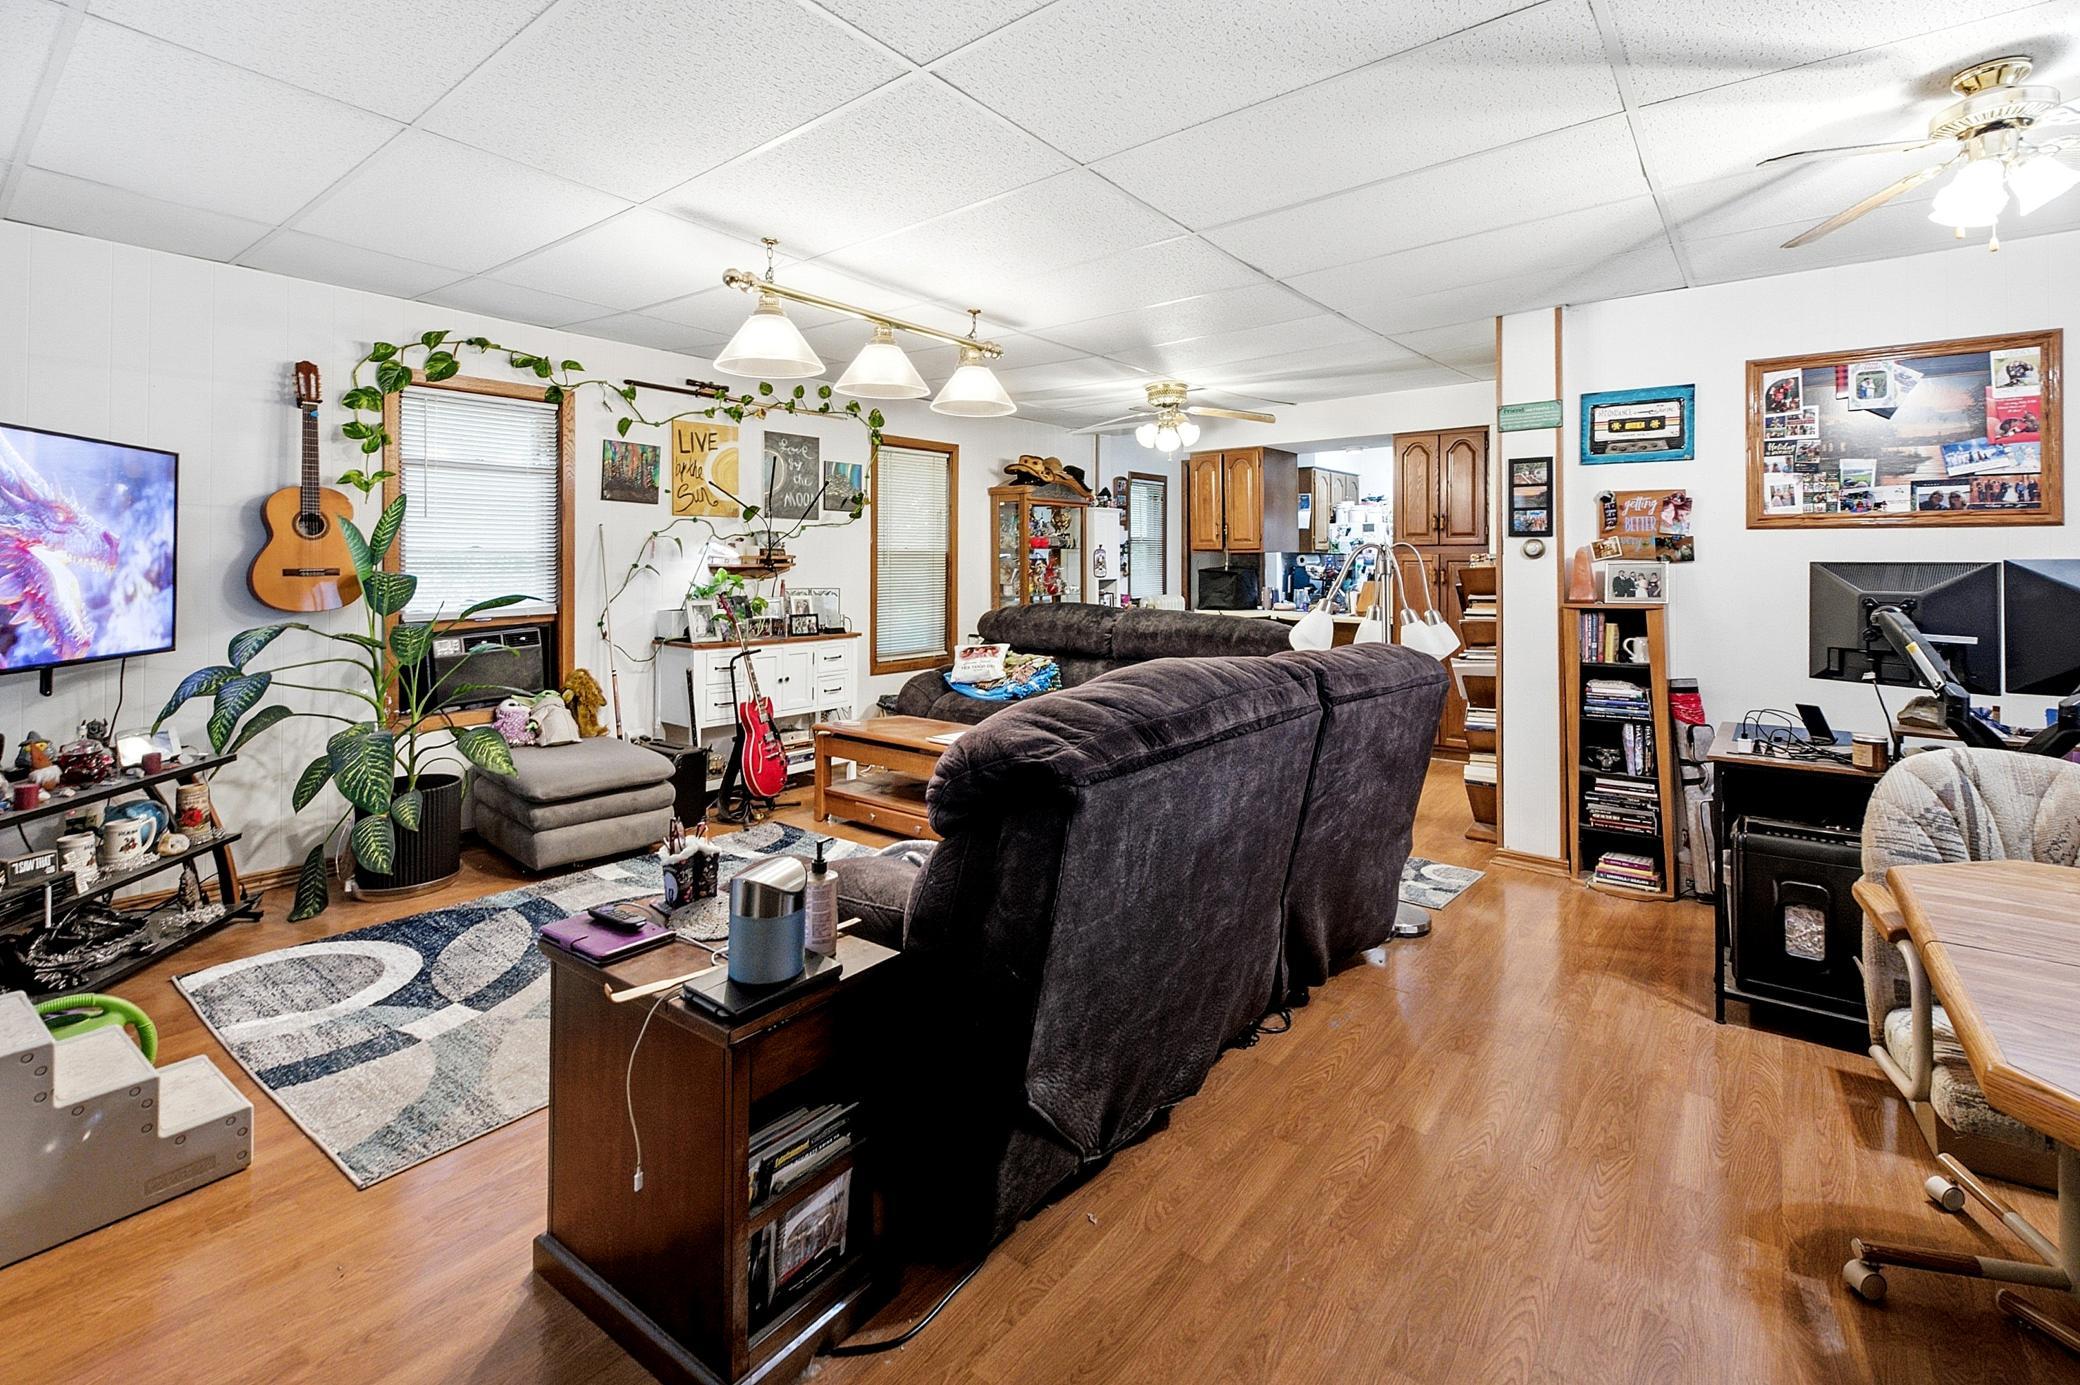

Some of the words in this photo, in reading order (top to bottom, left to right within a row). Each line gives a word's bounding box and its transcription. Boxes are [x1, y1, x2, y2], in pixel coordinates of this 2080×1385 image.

[677, 429, 719, 454] LIVE
[778, 438, 817, 460] Love
[675, 456, 687, 483] by
[687, 457, 705, 481] the
[793, 473, 813, 487] the
[675, 483, 720, 513] Sun
[1621, 496, 1658, 516] getting
